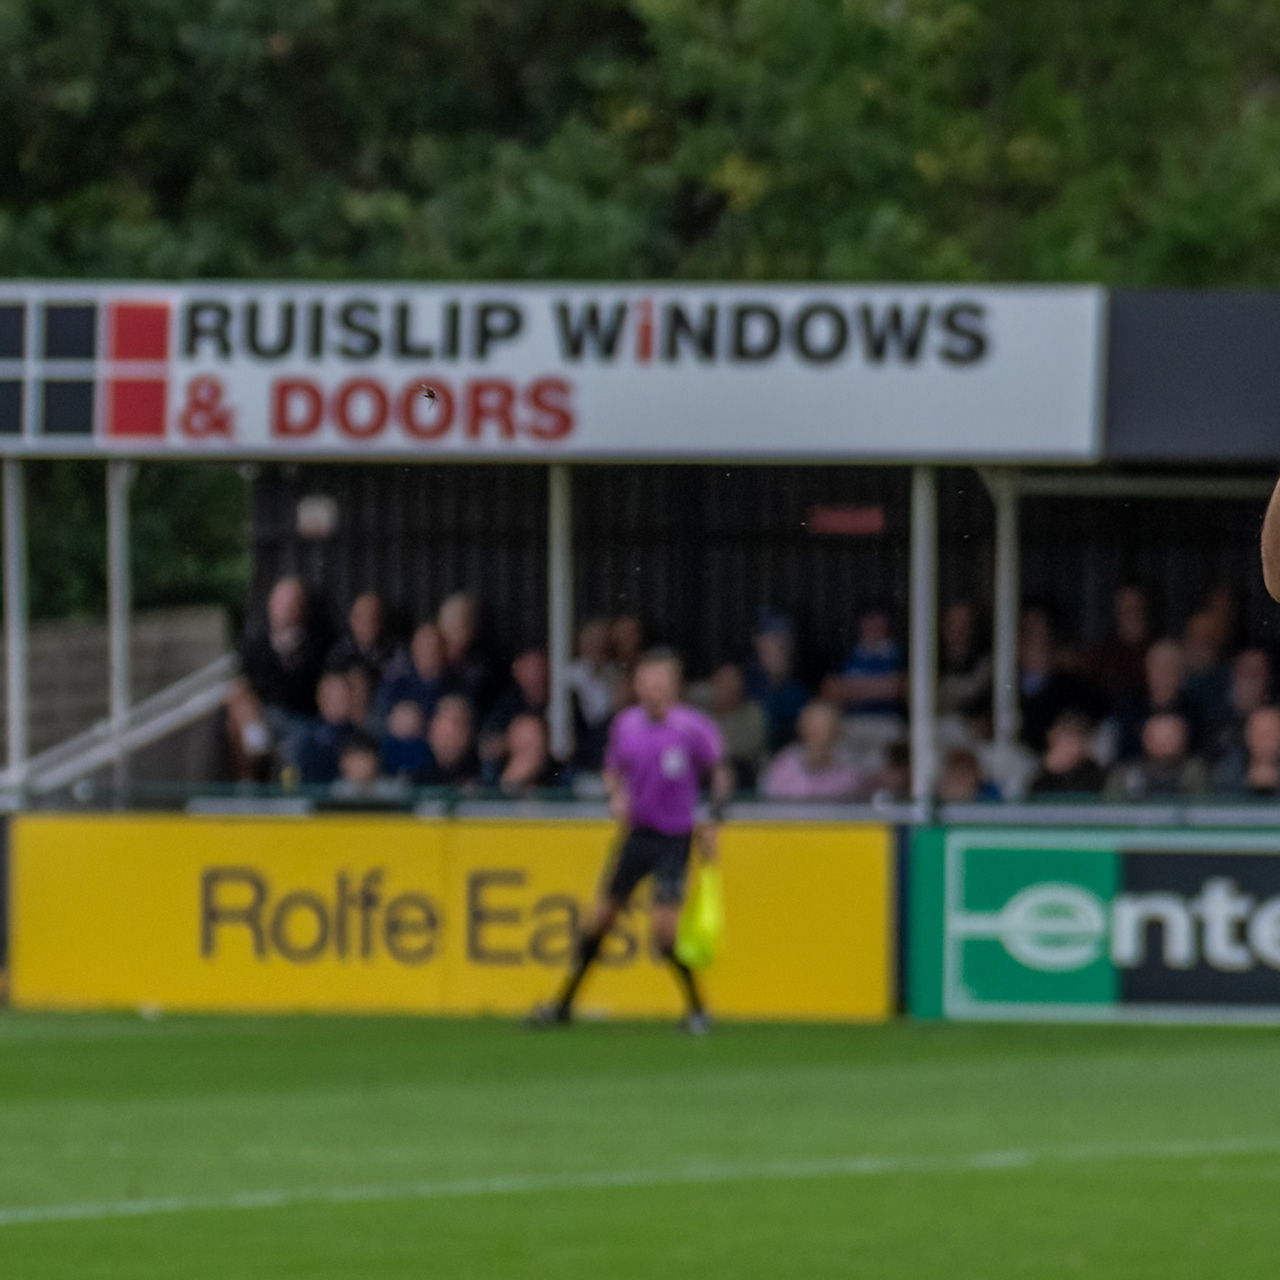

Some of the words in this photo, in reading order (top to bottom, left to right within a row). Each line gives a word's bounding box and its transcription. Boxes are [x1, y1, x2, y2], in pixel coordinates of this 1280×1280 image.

[182, 301, 523, 364] RUISLIP
[178, 376, 236, 443] &
[270, 376, 576, 443] DOORS
[200, 865, 441, 965] Rolfe
[466, 866, 676, 965] Eas
